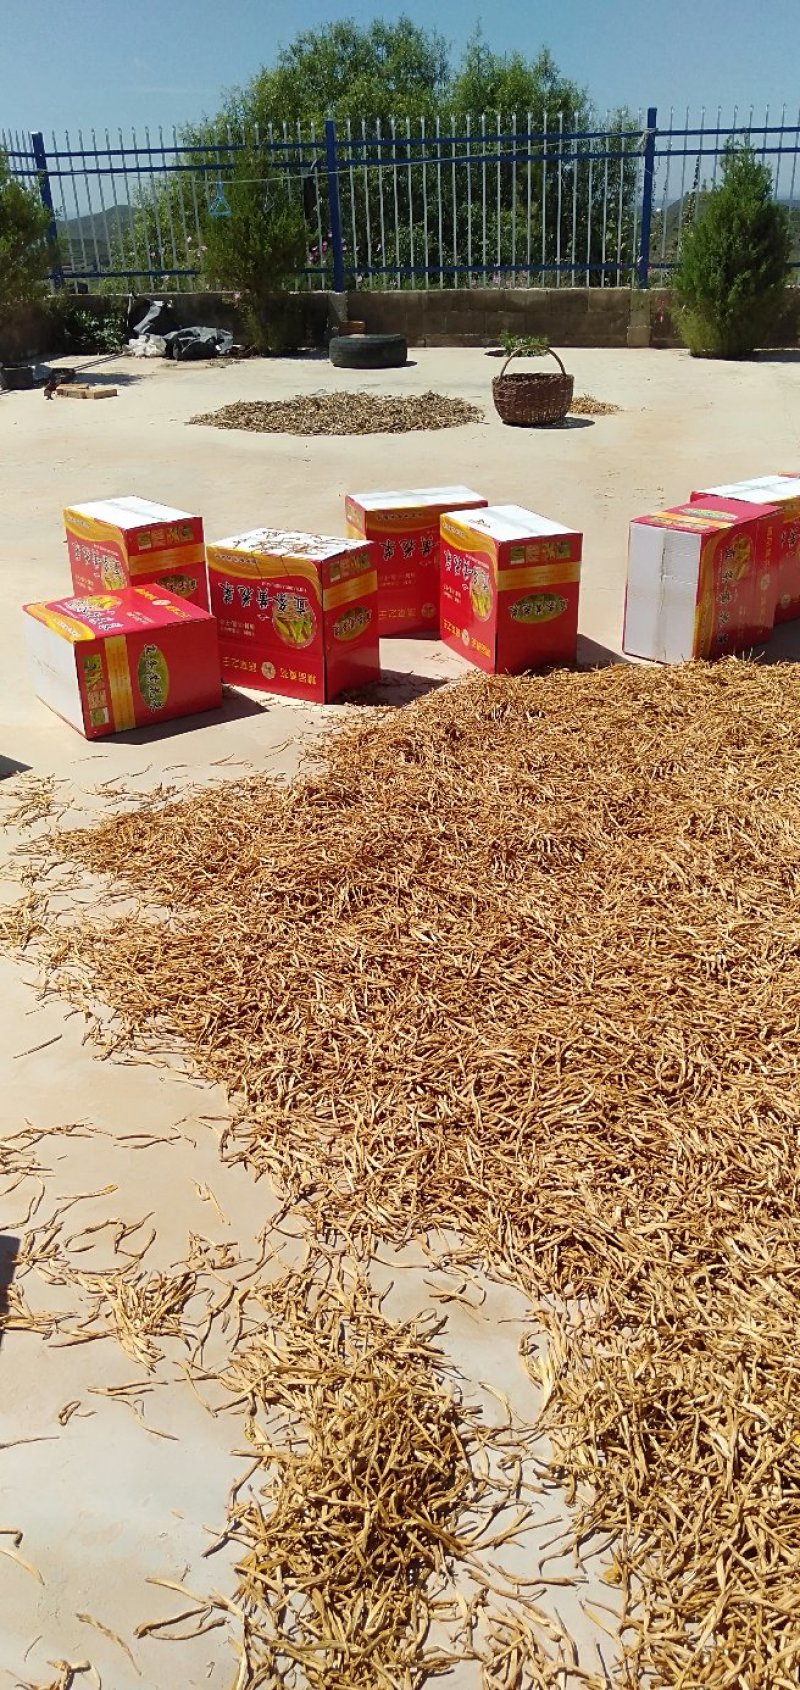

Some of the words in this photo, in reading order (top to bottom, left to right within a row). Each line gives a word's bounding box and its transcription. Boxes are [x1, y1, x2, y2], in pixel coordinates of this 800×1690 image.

[218, 581, 308, 616] 直条黄花菜
